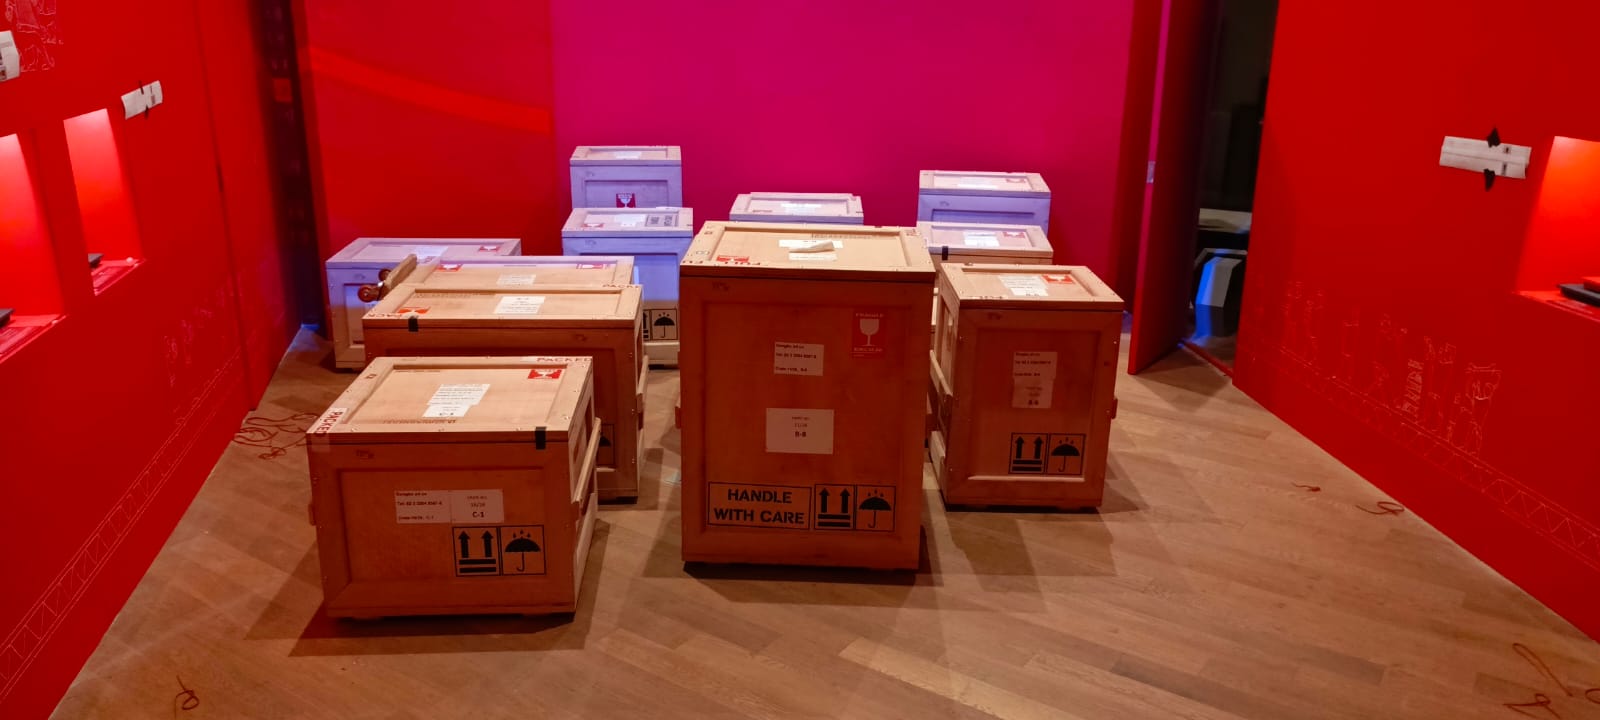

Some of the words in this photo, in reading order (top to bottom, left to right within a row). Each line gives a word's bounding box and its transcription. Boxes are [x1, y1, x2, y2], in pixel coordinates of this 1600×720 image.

[727, 488, 793, 504] HANDLE
[713, 507, 755, 522] WITH
[760, 510, 805, 525] CARE
